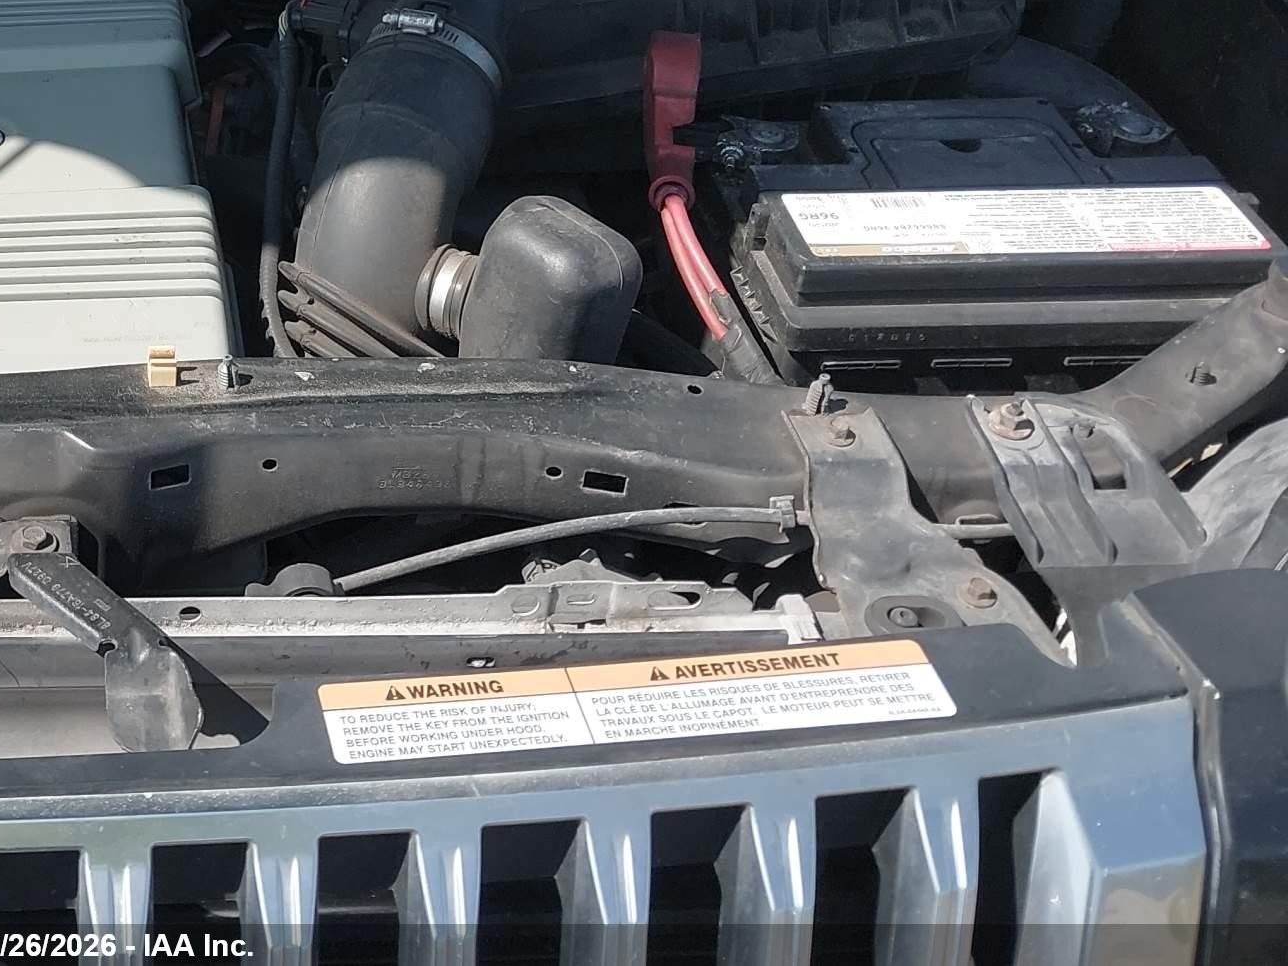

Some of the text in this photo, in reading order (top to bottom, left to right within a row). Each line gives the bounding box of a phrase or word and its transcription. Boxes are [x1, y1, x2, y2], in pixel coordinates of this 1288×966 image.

[675, 653, 841, 681] AVERTISSEMENT
[407, 680, 504, 699] WARNING
[340, 706, 486, 724] TO REDUCE THE RISK OF
[343, 711, 569, 737] REMOVE THE KEY FROM THE IGNITION
[346, 736, 394, 747] BEFORE
[398, 731, 458, 742] WORKING
[461, 727, 503, 738] UNDER
[349, 748, 394, 759] ENGINE
[398, 745, 423, 754] MAY
[427, 742, 464, 752] START
